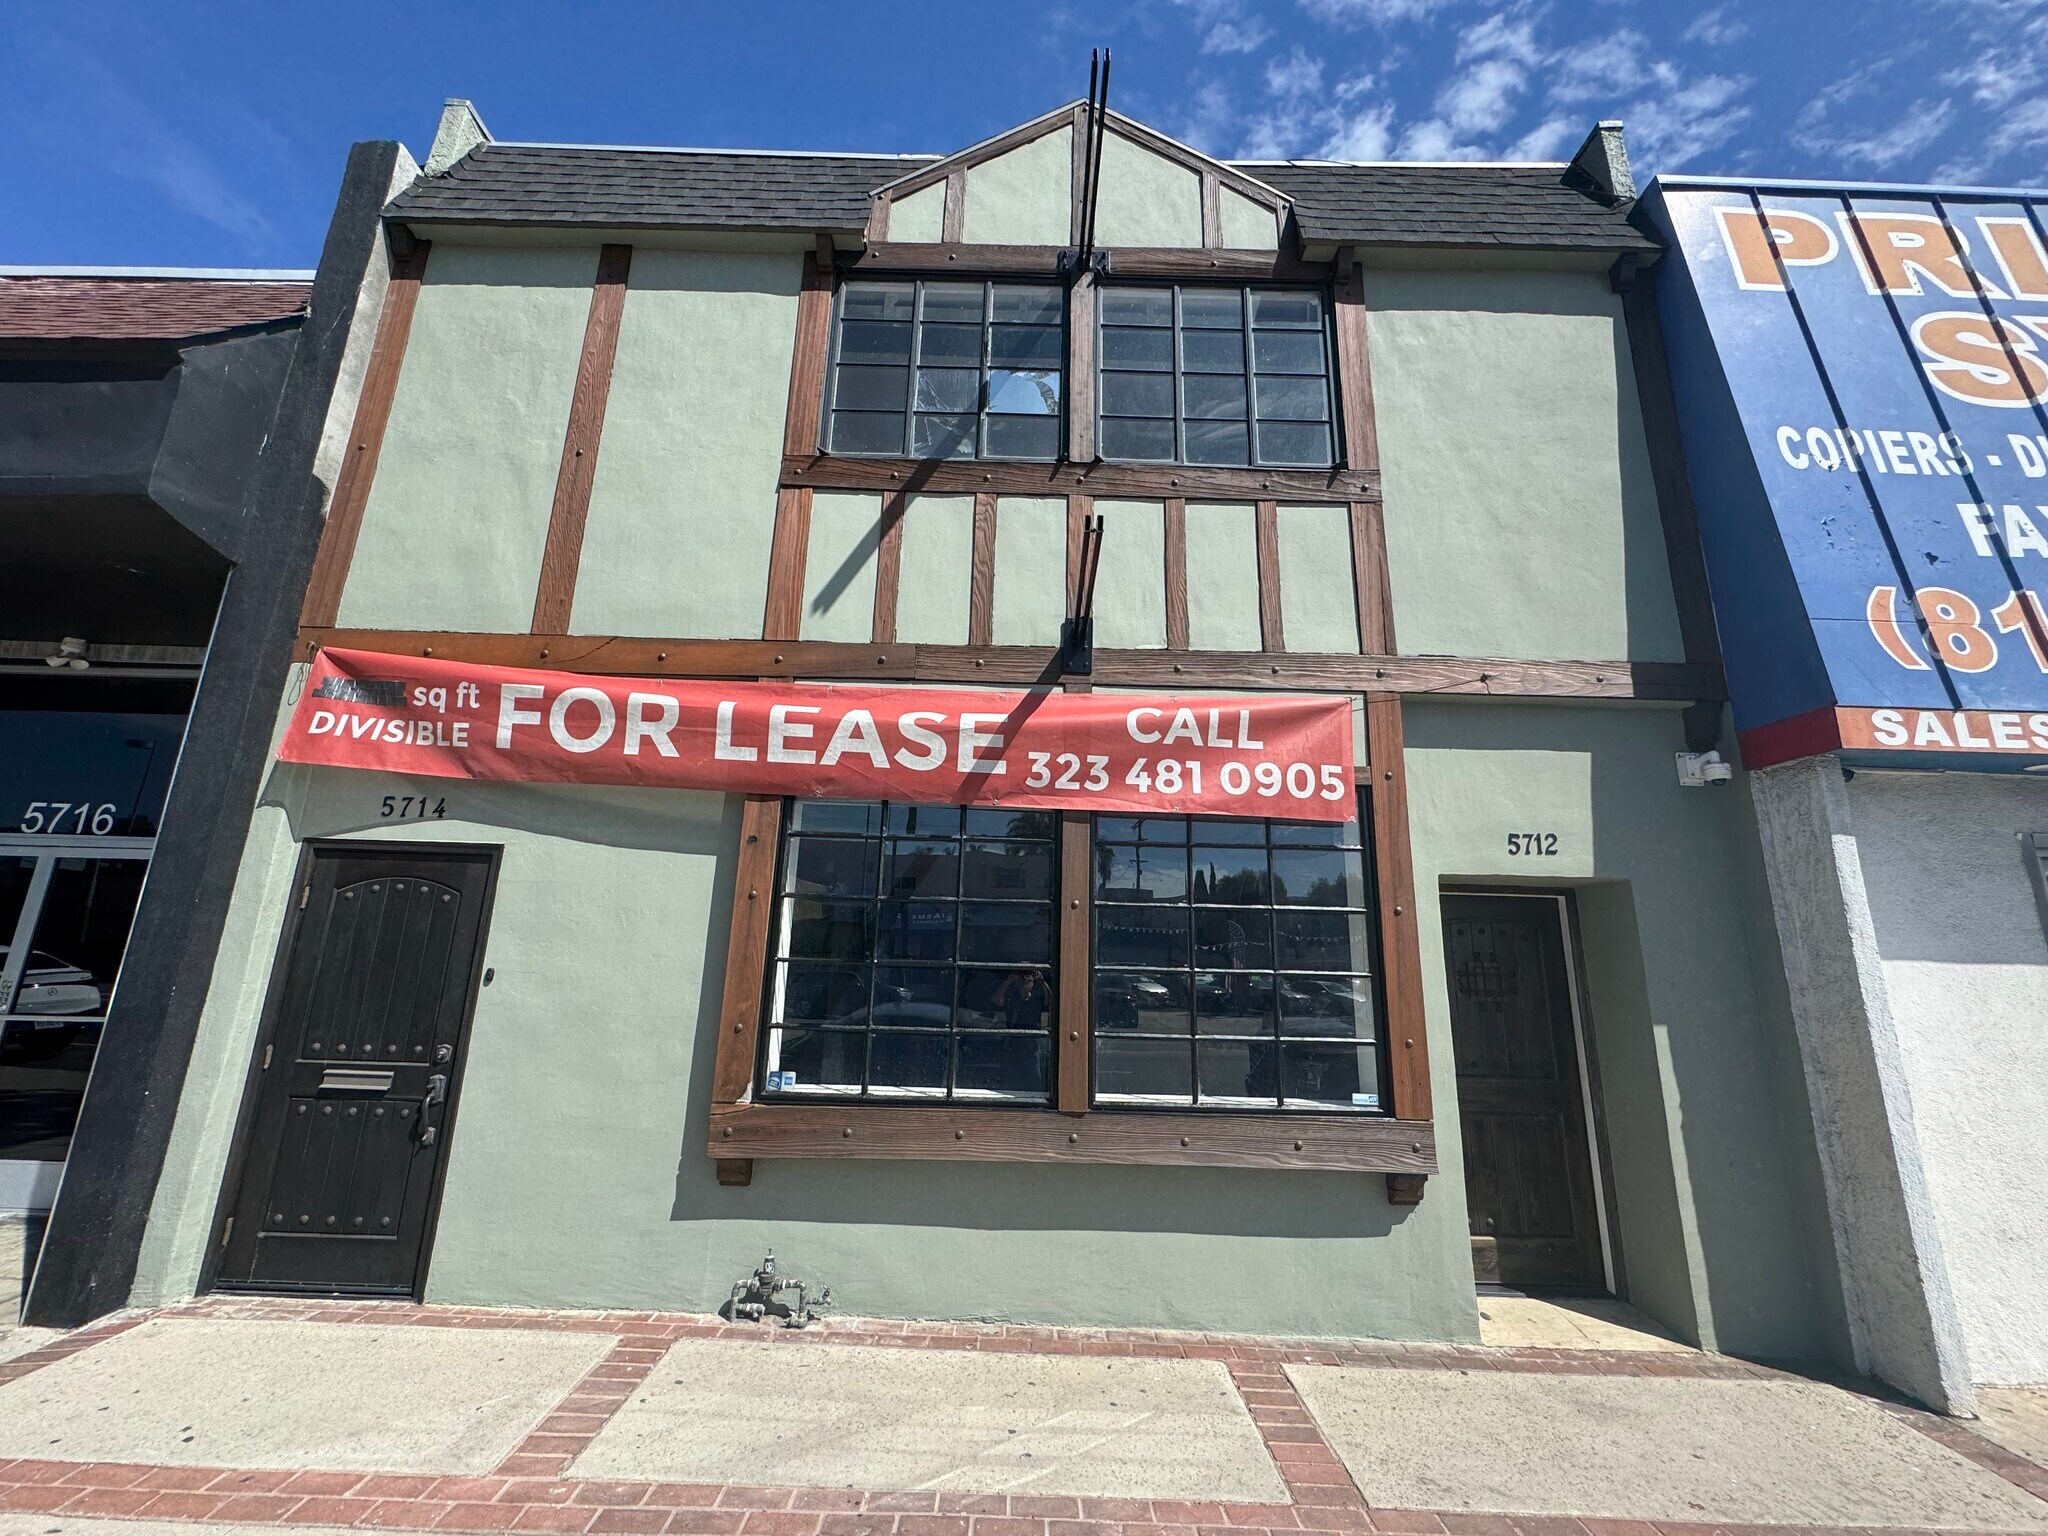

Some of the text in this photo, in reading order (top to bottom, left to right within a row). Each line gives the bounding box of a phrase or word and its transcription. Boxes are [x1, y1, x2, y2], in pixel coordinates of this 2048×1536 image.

[1910, 310, 2048, 408] S
[1776, 425, 1975, 476] COPIERS
[1956, 503, 2048, 559] FA
[413, 681, 481, 713] sq ft
[308, 711, 470, 748] DIVISIBLE
[495, 683, 1008, 775] FOR LEASE
[1126, 707, 1264, 749] CALL
[1025, 751, 1345, 800] 323 481 0905
[21, 802, 117, 835] 5716
[381, 796, 446, 818] 5714
[1507, 833, 1558, 856] 5712
